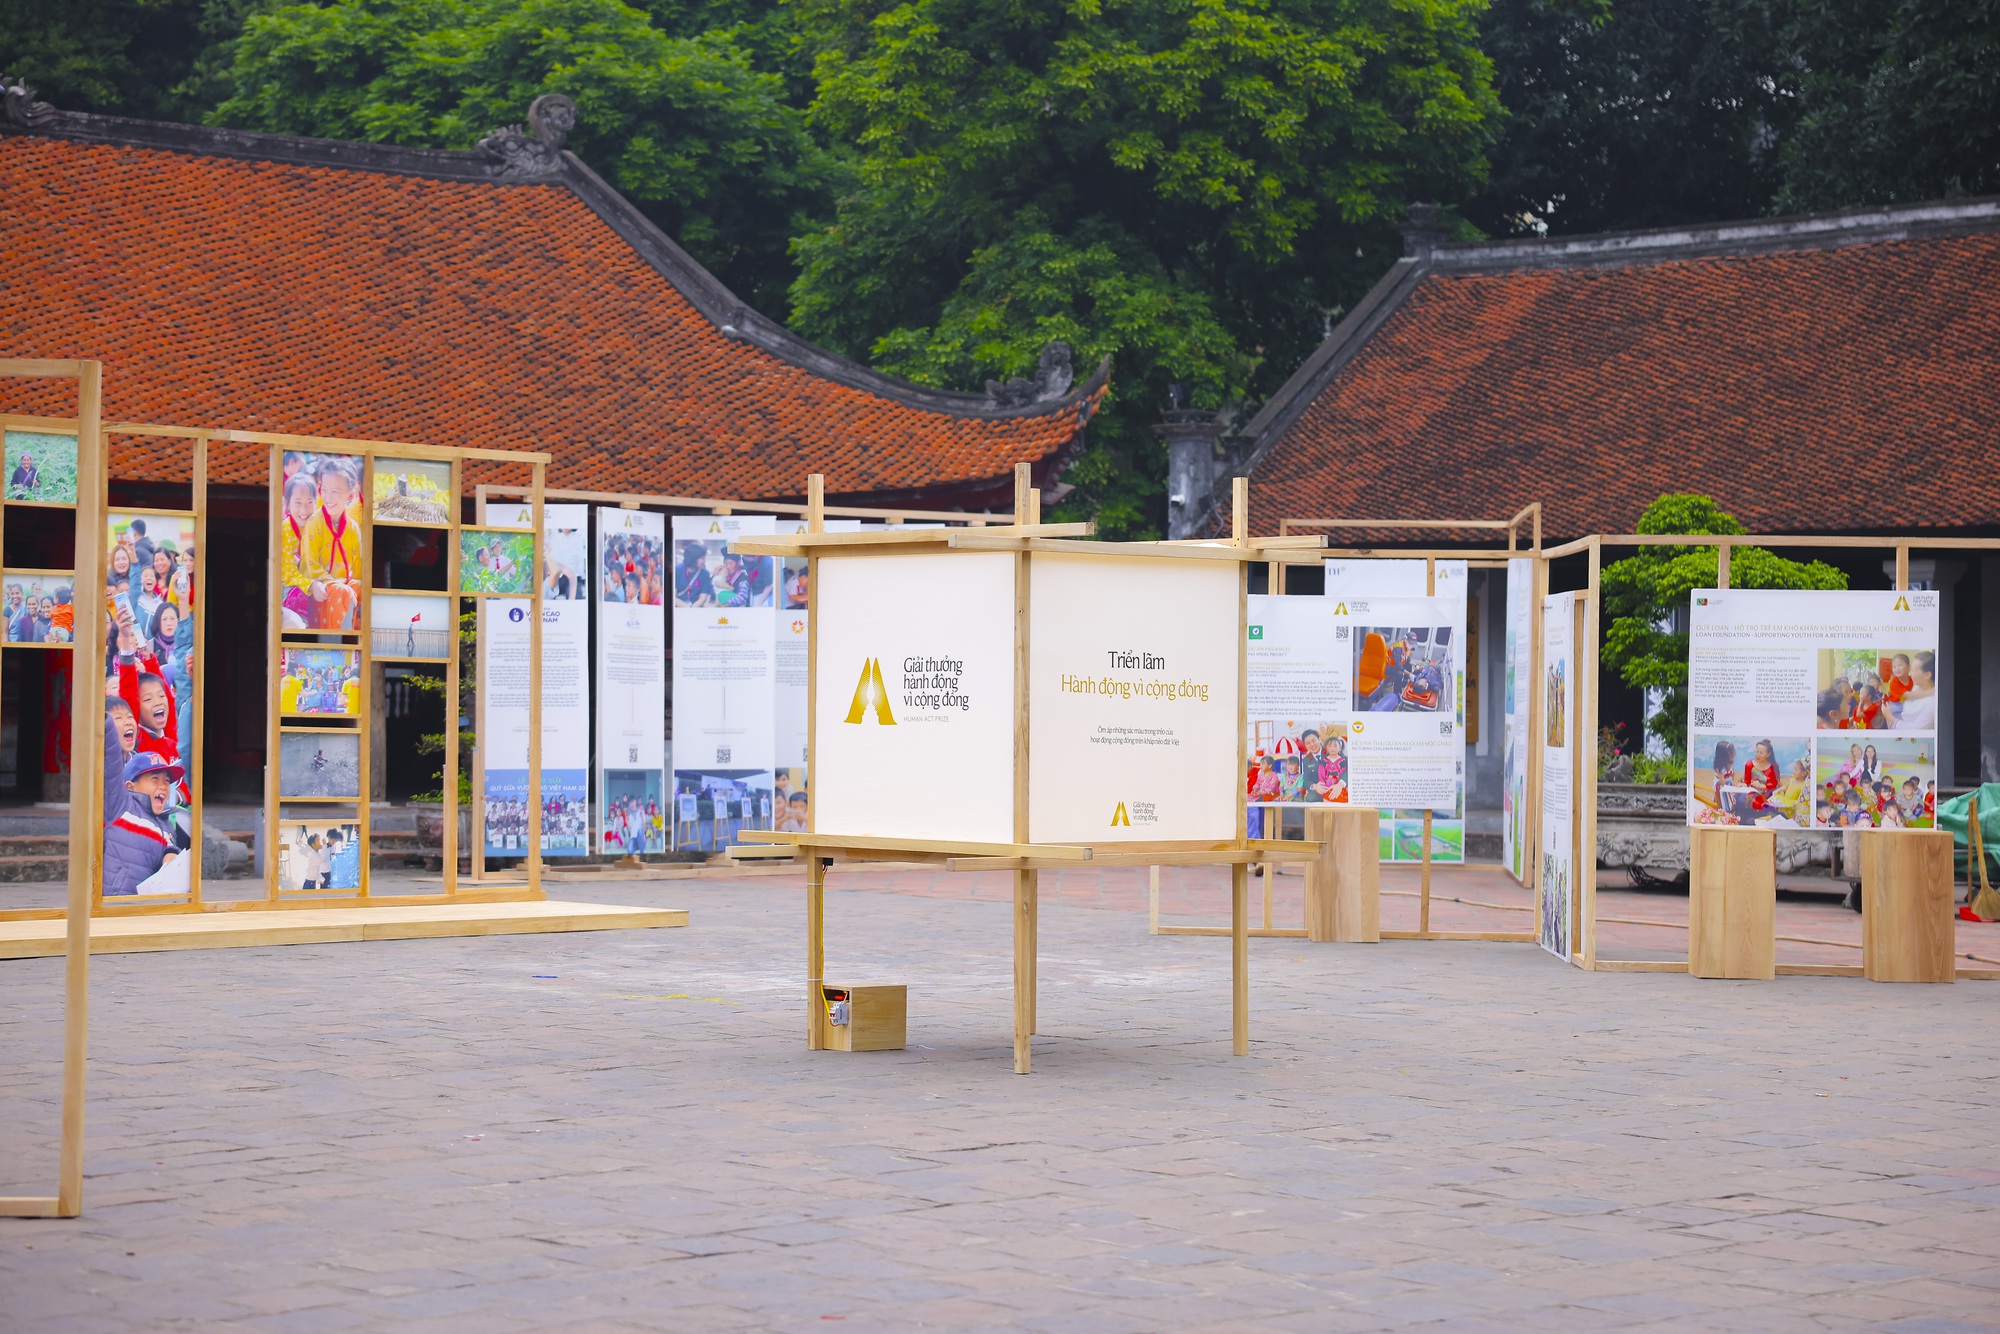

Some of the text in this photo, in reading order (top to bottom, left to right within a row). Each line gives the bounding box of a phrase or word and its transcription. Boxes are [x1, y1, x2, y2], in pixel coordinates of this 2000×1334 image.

[1754, 631, 1791, 639] SUPPORTING
[903, 654, 964, 676] Giải thưởng
[1107, 649, 1165, 670] Triển lãm
[903, 673, 959, 693] hành động
[1061, 674, 1209, 702] Hành động vì cộng đồng
[903, 690, 970, 711] vì cộng đồng
[903, 715, 949, 723] HUMAN ACT PRIZE
